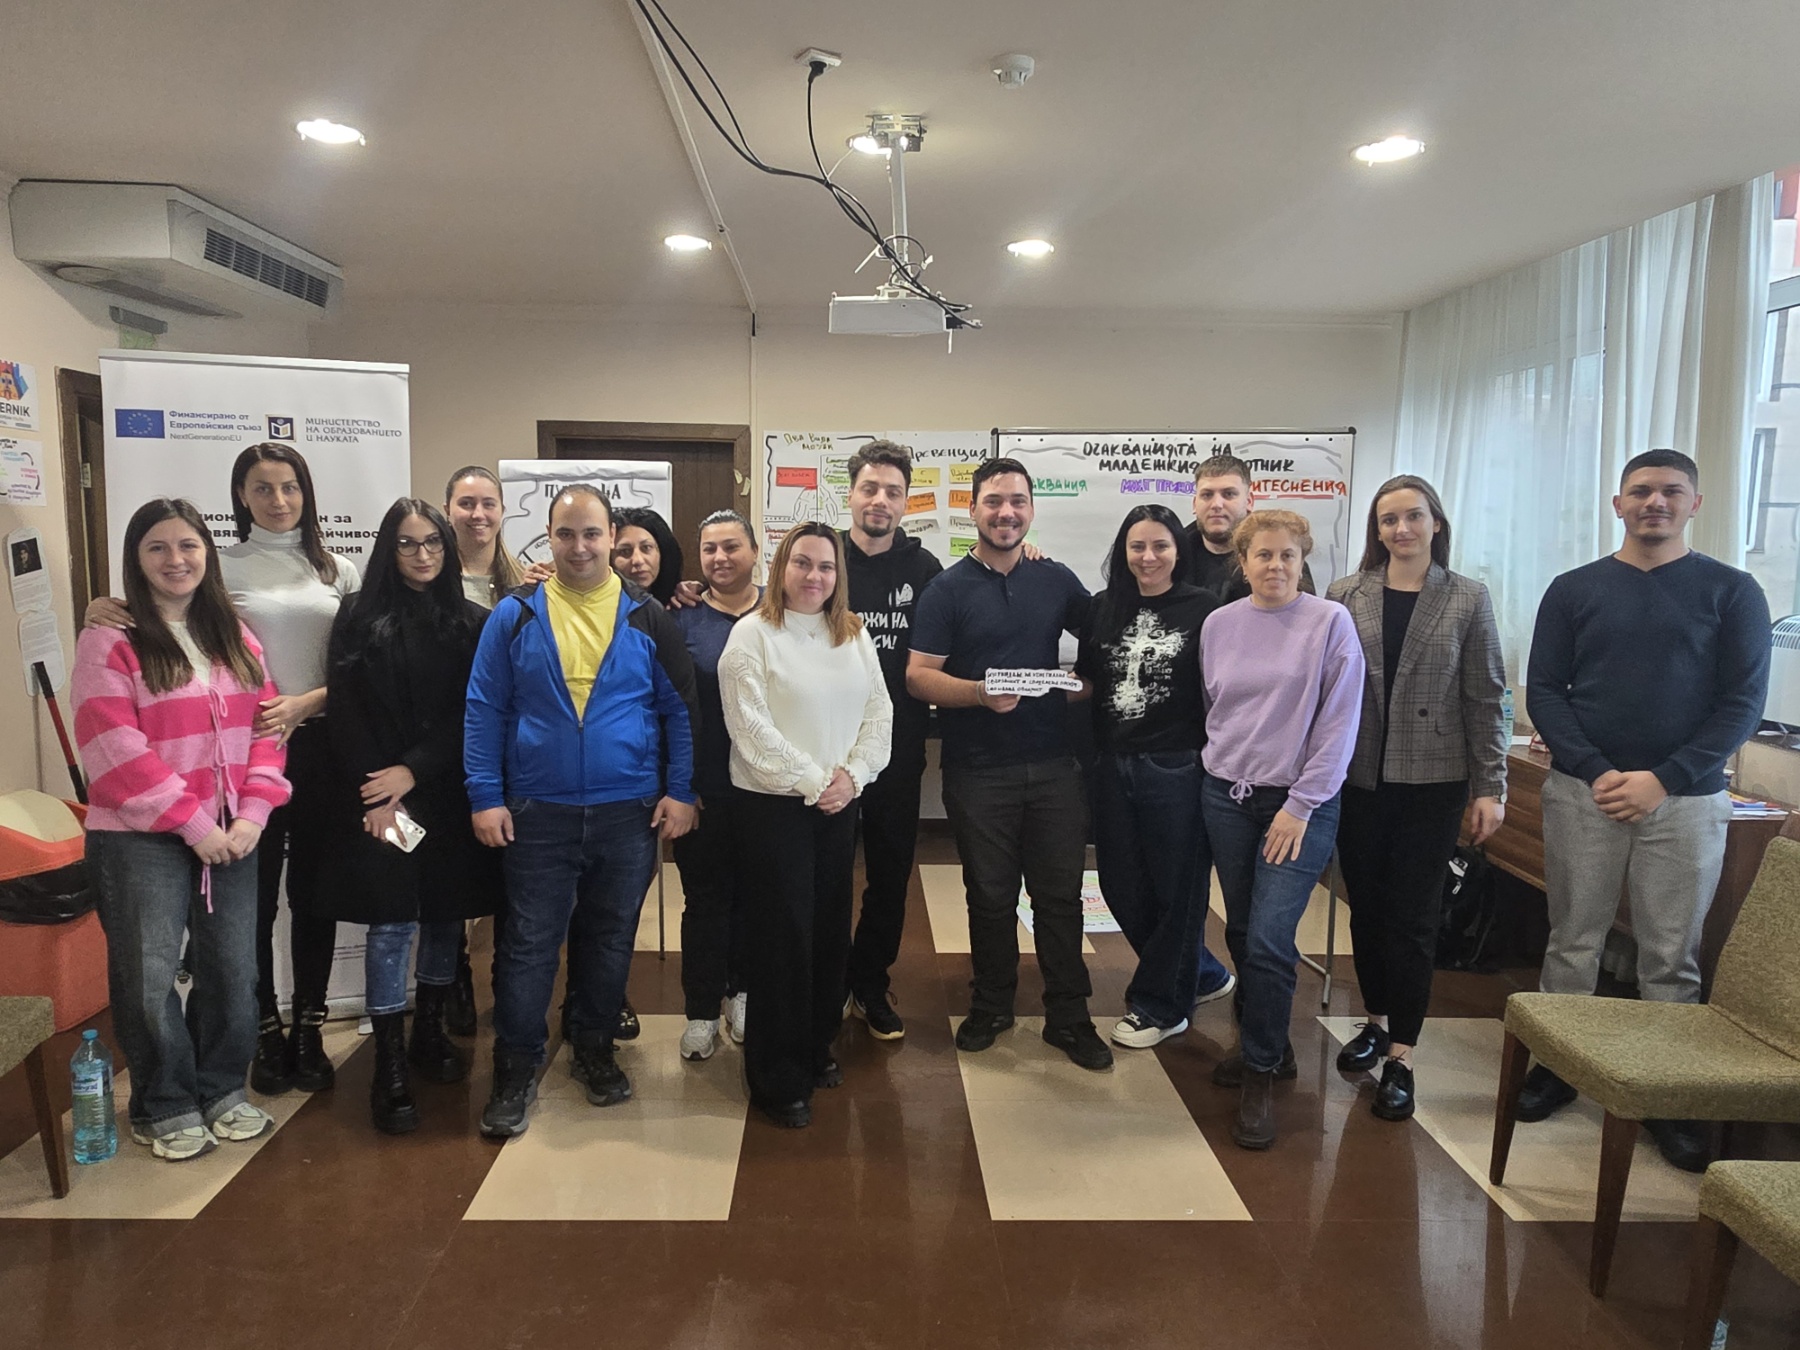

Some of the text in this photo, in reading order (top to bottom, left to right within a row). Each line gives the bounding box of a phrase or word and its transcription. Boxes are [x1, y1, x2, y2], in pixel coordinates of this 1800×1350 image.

[0, 402, 30, 417] ERNIK
[169, 410, 236, 421] Финансирано
[169, 420, 234, 430] Европейския
[305, 418, 380, 428] МИНИСТЕРСТВО
[323, 427, 402, 437] ОБРАЗОВАНИЕТО
[170, 433, 241, 442] NextGenerationEU
[316, 435, 359, 443] НАУКАТА
[1211, 442, 1232, 456] НА
[1244, 459, 1294, 472] ОТНИК
[1034, 478, 1088, 492] КВАНИЯ
[334, 515, 352, 523] за
[892, 612, 909, 629] НА
